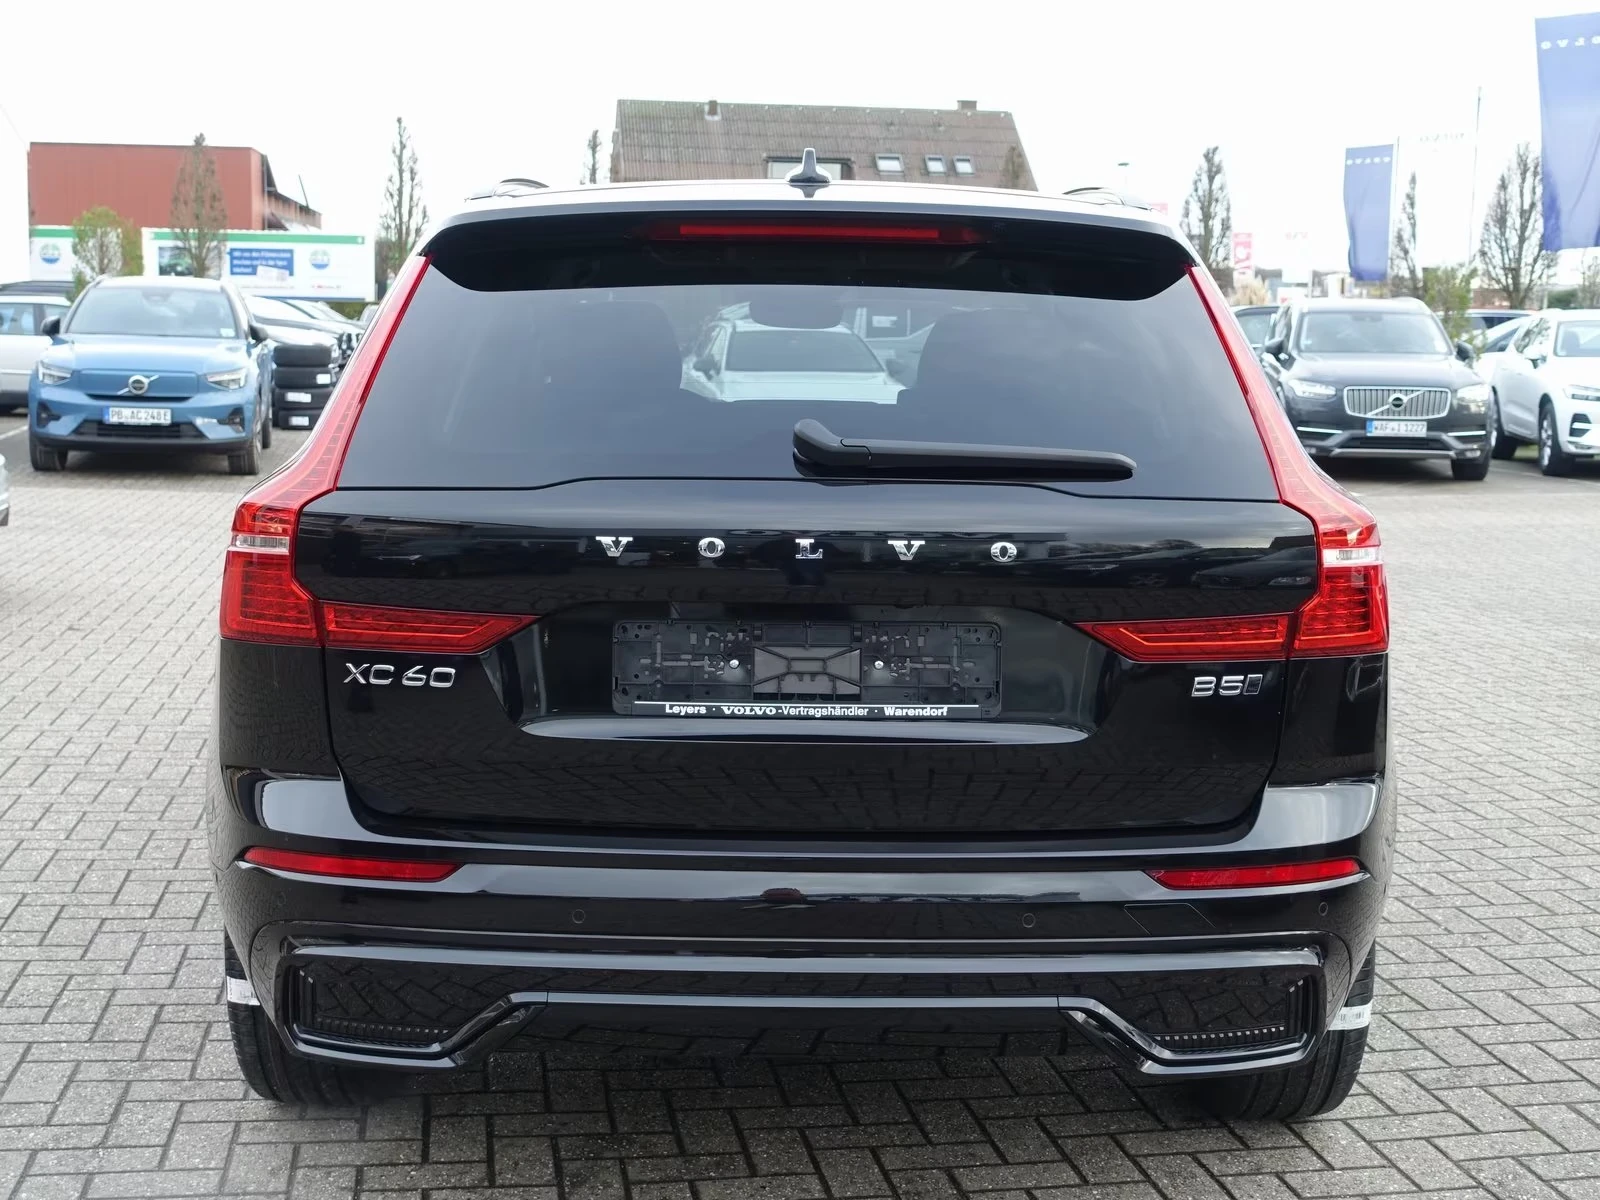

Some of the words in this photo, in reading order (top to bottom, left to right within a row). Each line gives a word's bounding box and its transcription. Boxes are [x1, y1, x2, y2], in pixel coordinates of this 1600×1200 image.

[596, 536, 1018, 562] VOLVO
[665, 703, 707, 716] Leyers
[884, 706, 948, 717] Warendorf
